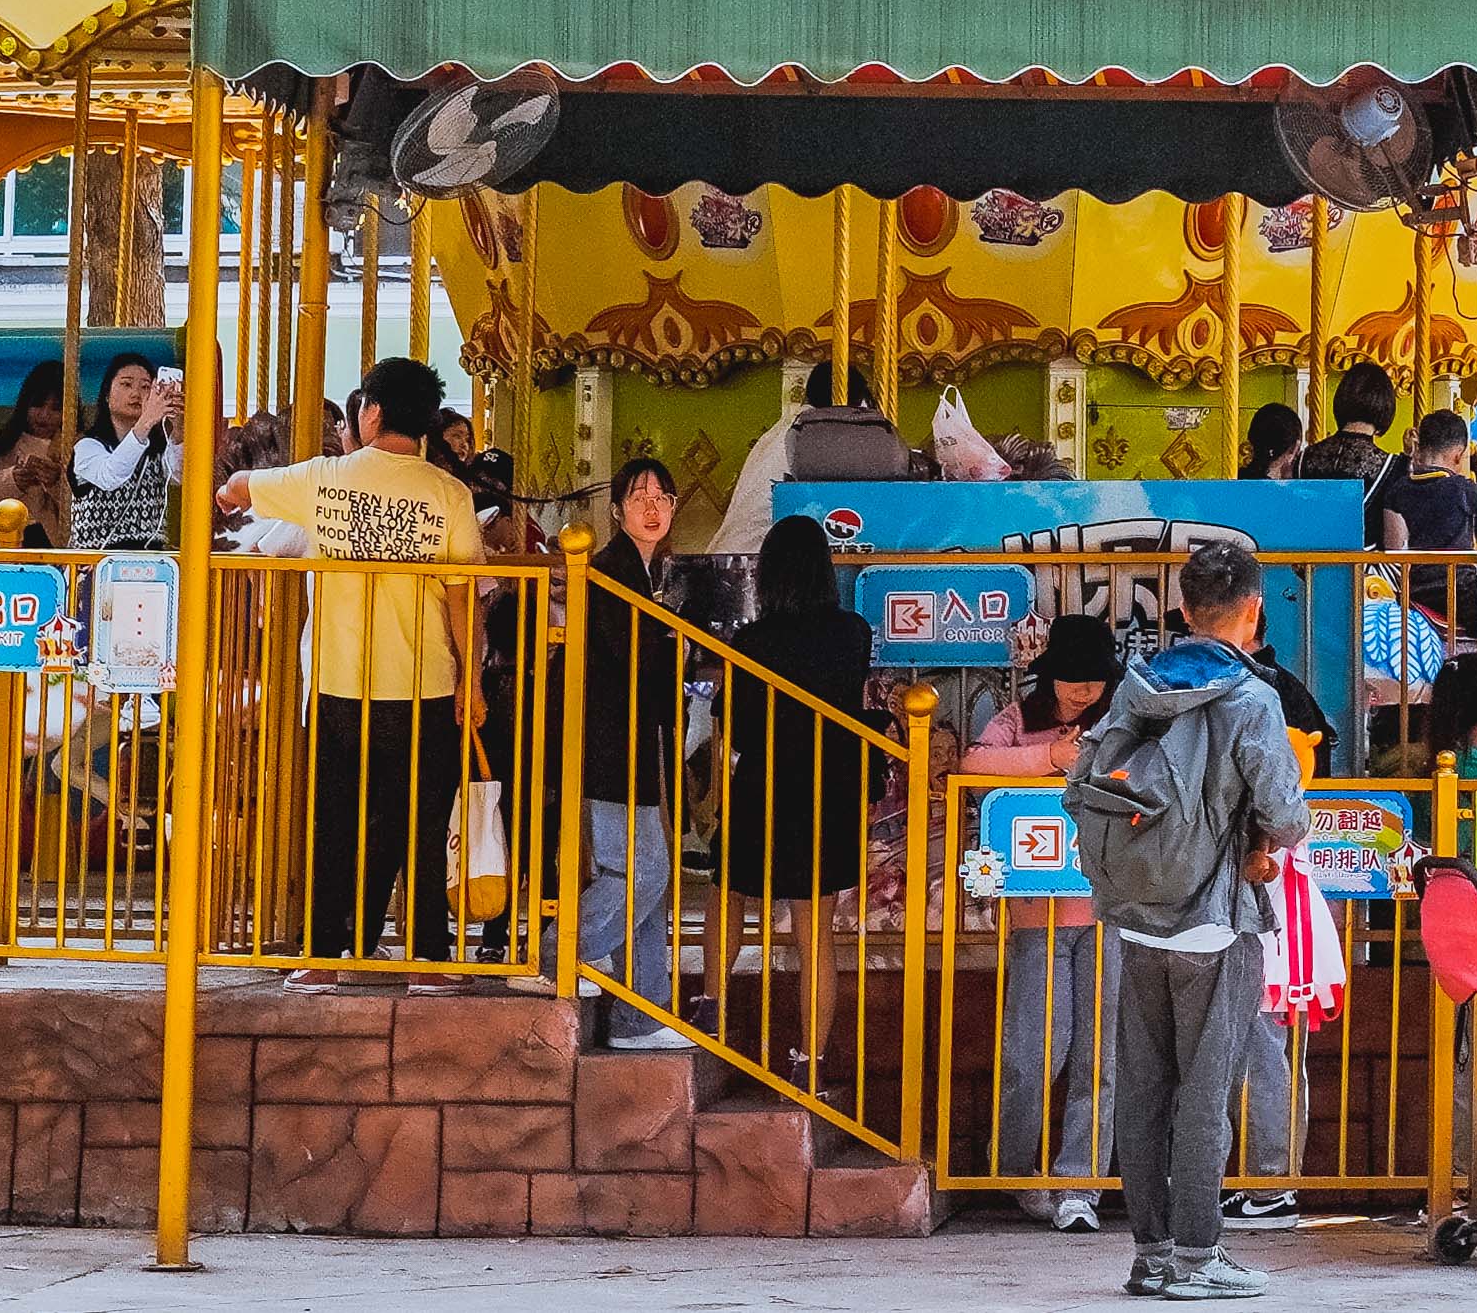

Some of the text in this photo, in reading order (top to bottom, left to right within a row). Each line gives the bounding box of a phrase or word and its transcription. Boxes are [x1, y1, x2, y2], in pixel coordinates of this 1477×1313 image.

[317, 486, 429, 513] MODERN LOVE
[315, 506, 371, 524] FUTURE
[350, 501, 445, 529] BREAKS ME
[316, 525, 380, 543] MODERN
[420, 532, 443, 546] ME
[942, 589, 1010, 623] 入口
[944, 628, 1005, 643] ENTER
